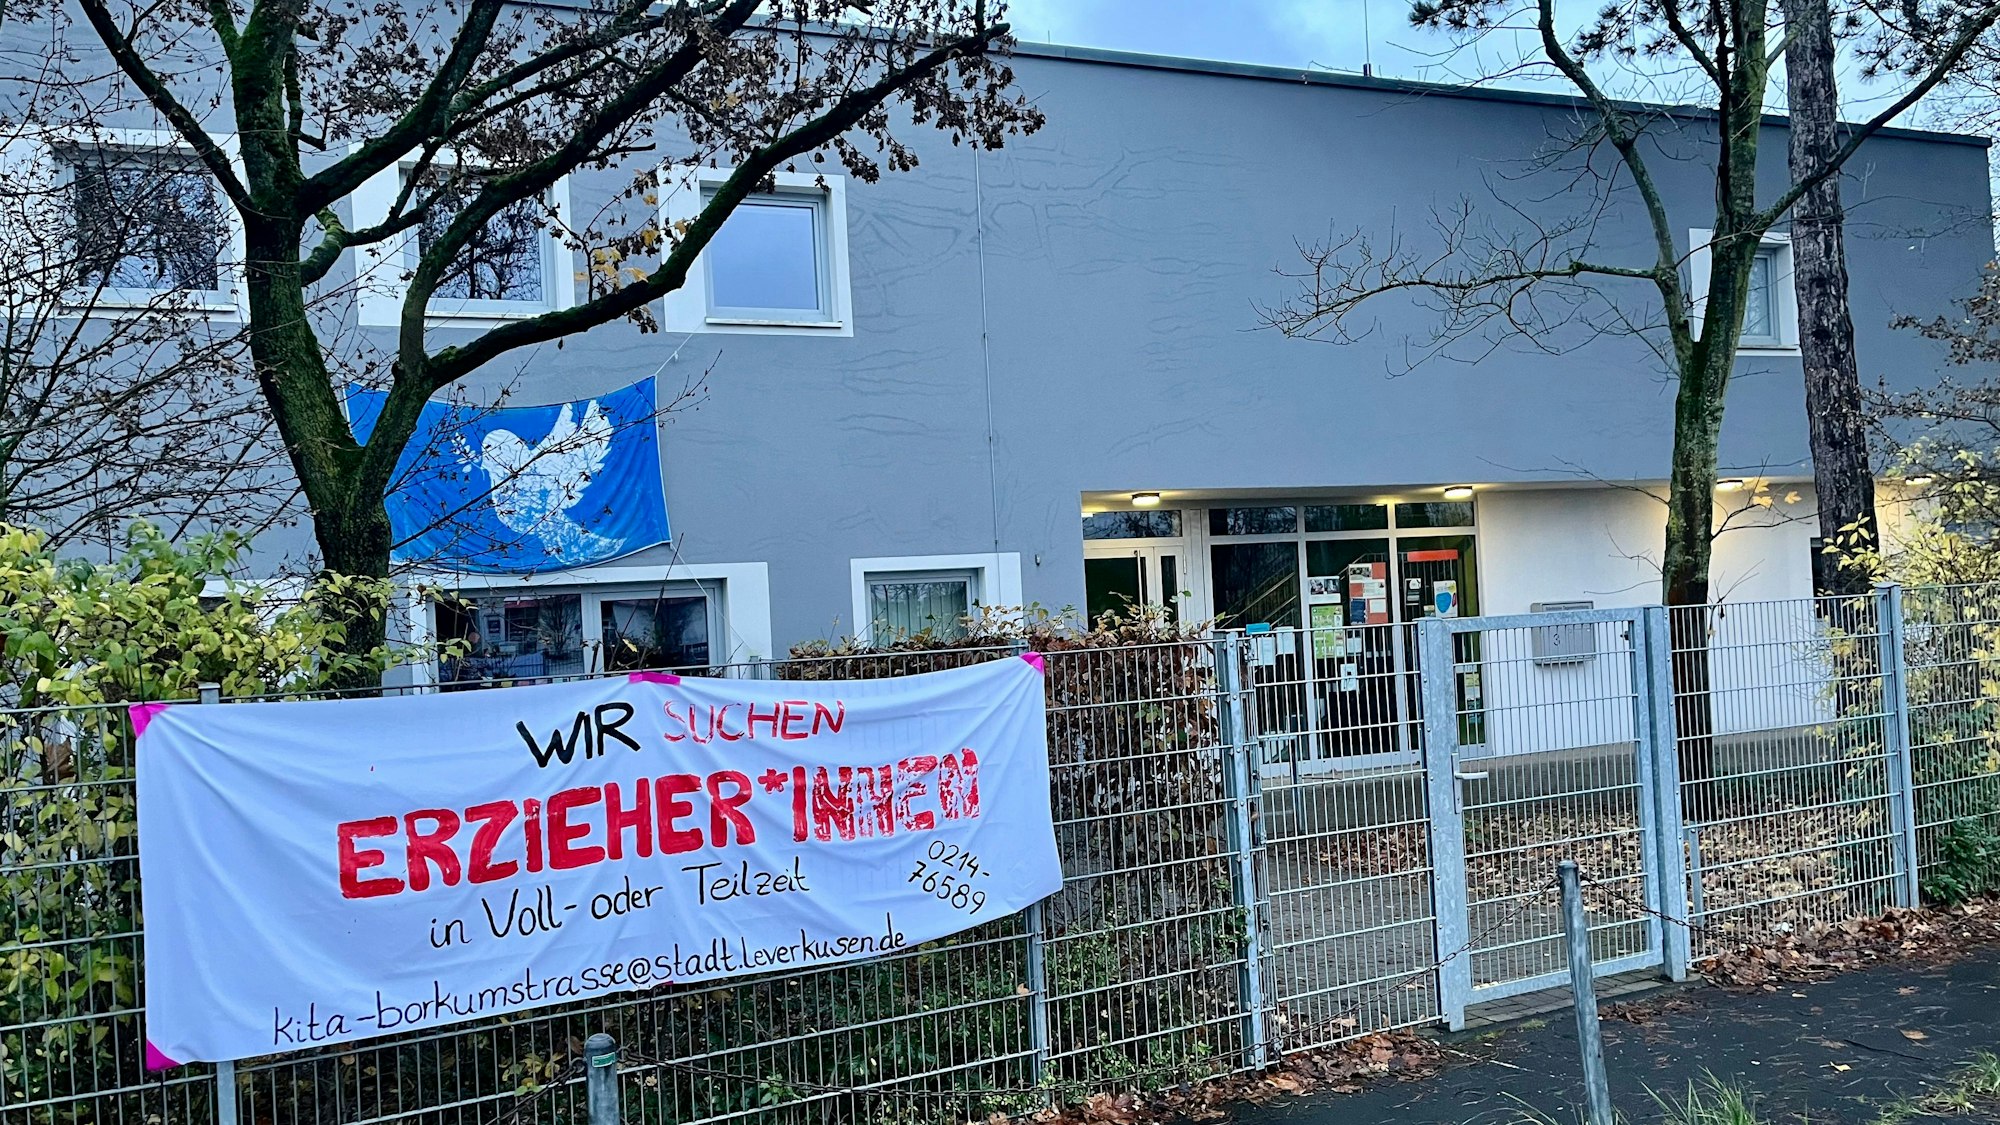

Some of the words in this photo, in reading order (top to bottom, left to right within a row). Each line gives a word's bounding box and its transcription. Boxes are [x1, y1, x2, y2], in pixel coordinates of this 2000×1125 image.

[516, 702, 641, 768] WIR
[664, 701, 846, 743] SUCHEN
[908, 860, 986, 915] 76589
[927, 840, 990, 879] 0214-
[430, 918, 472, 949] in
[481, 885, 577, 938] Voll-
[591, 875, 664, 920] oder
[681, 856, 811, 906] Teilzeit
[273, 912, 907, 1046] kita-borkumstrasse@stadt.leverkusen.de
